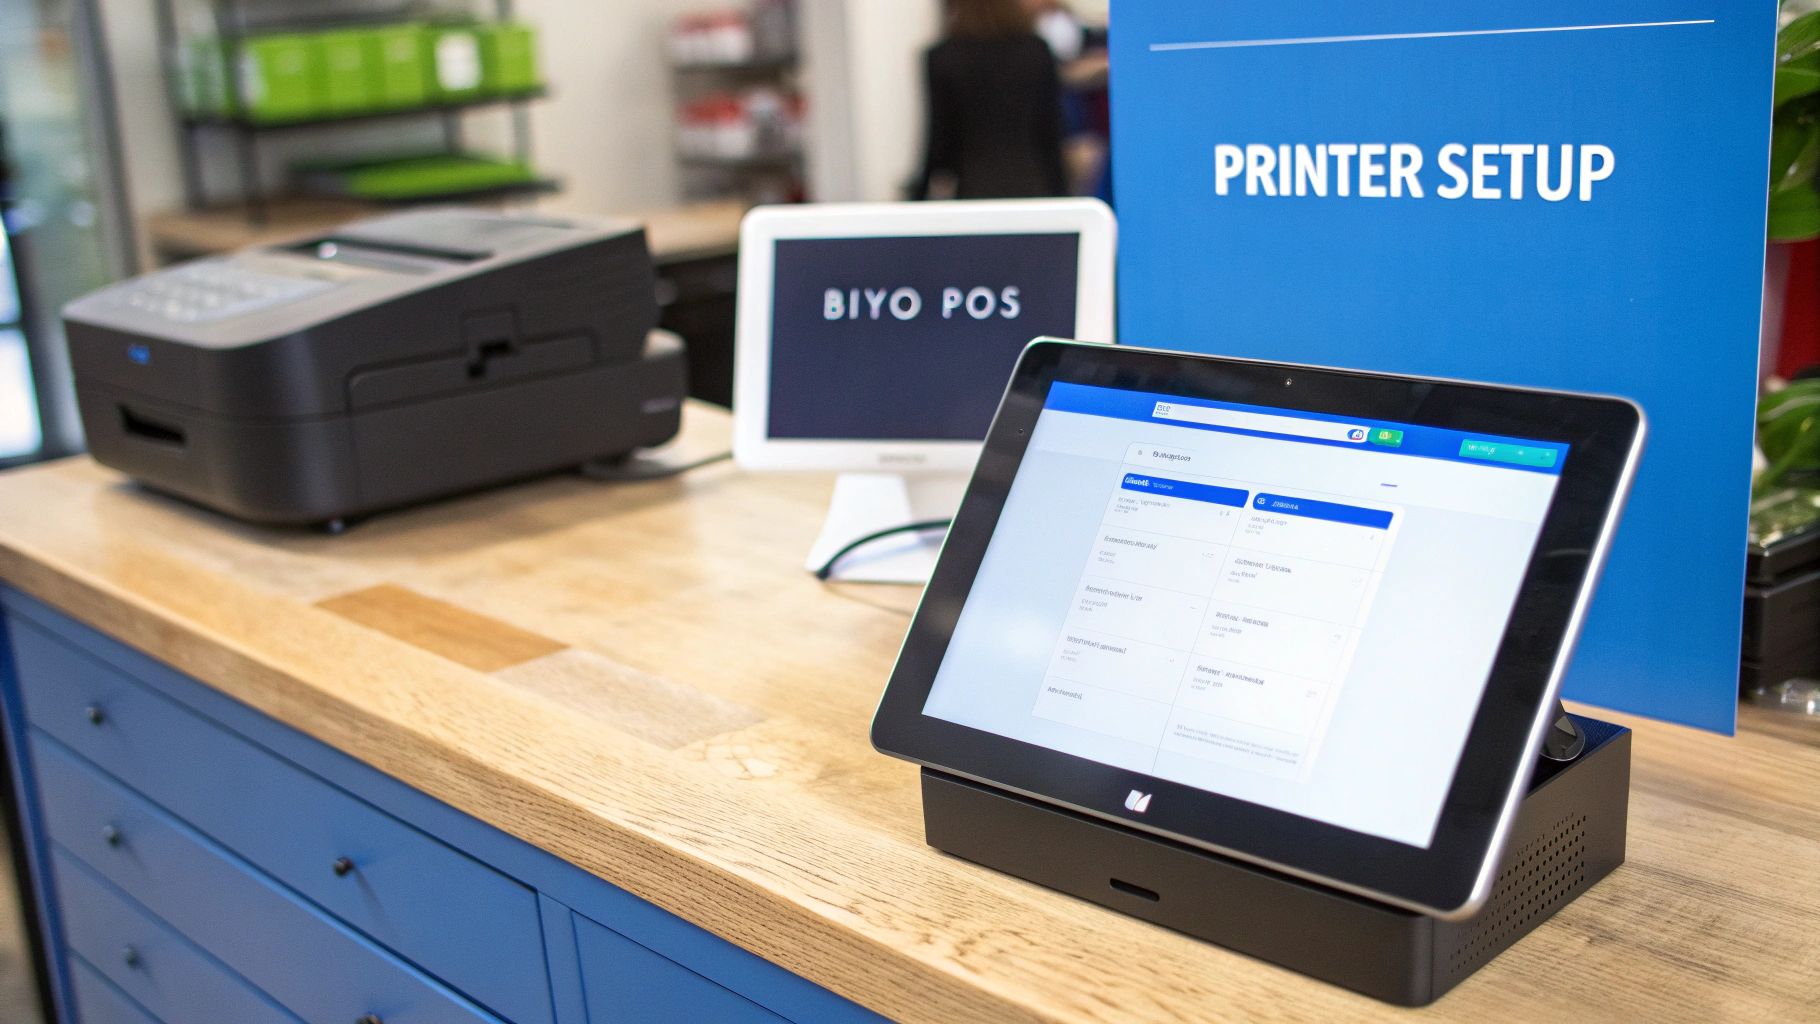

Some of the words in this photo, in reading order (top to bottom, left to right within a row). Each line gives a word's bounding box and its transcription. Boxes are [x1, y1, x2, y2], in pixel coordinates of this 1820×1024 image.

[1214, 143, 1425, 199] PRINTER
[1436, 142, 1616, 202] SETUP
[822, 287, 922, 321] BIYO
[941, 285, 1021, 320] POS
